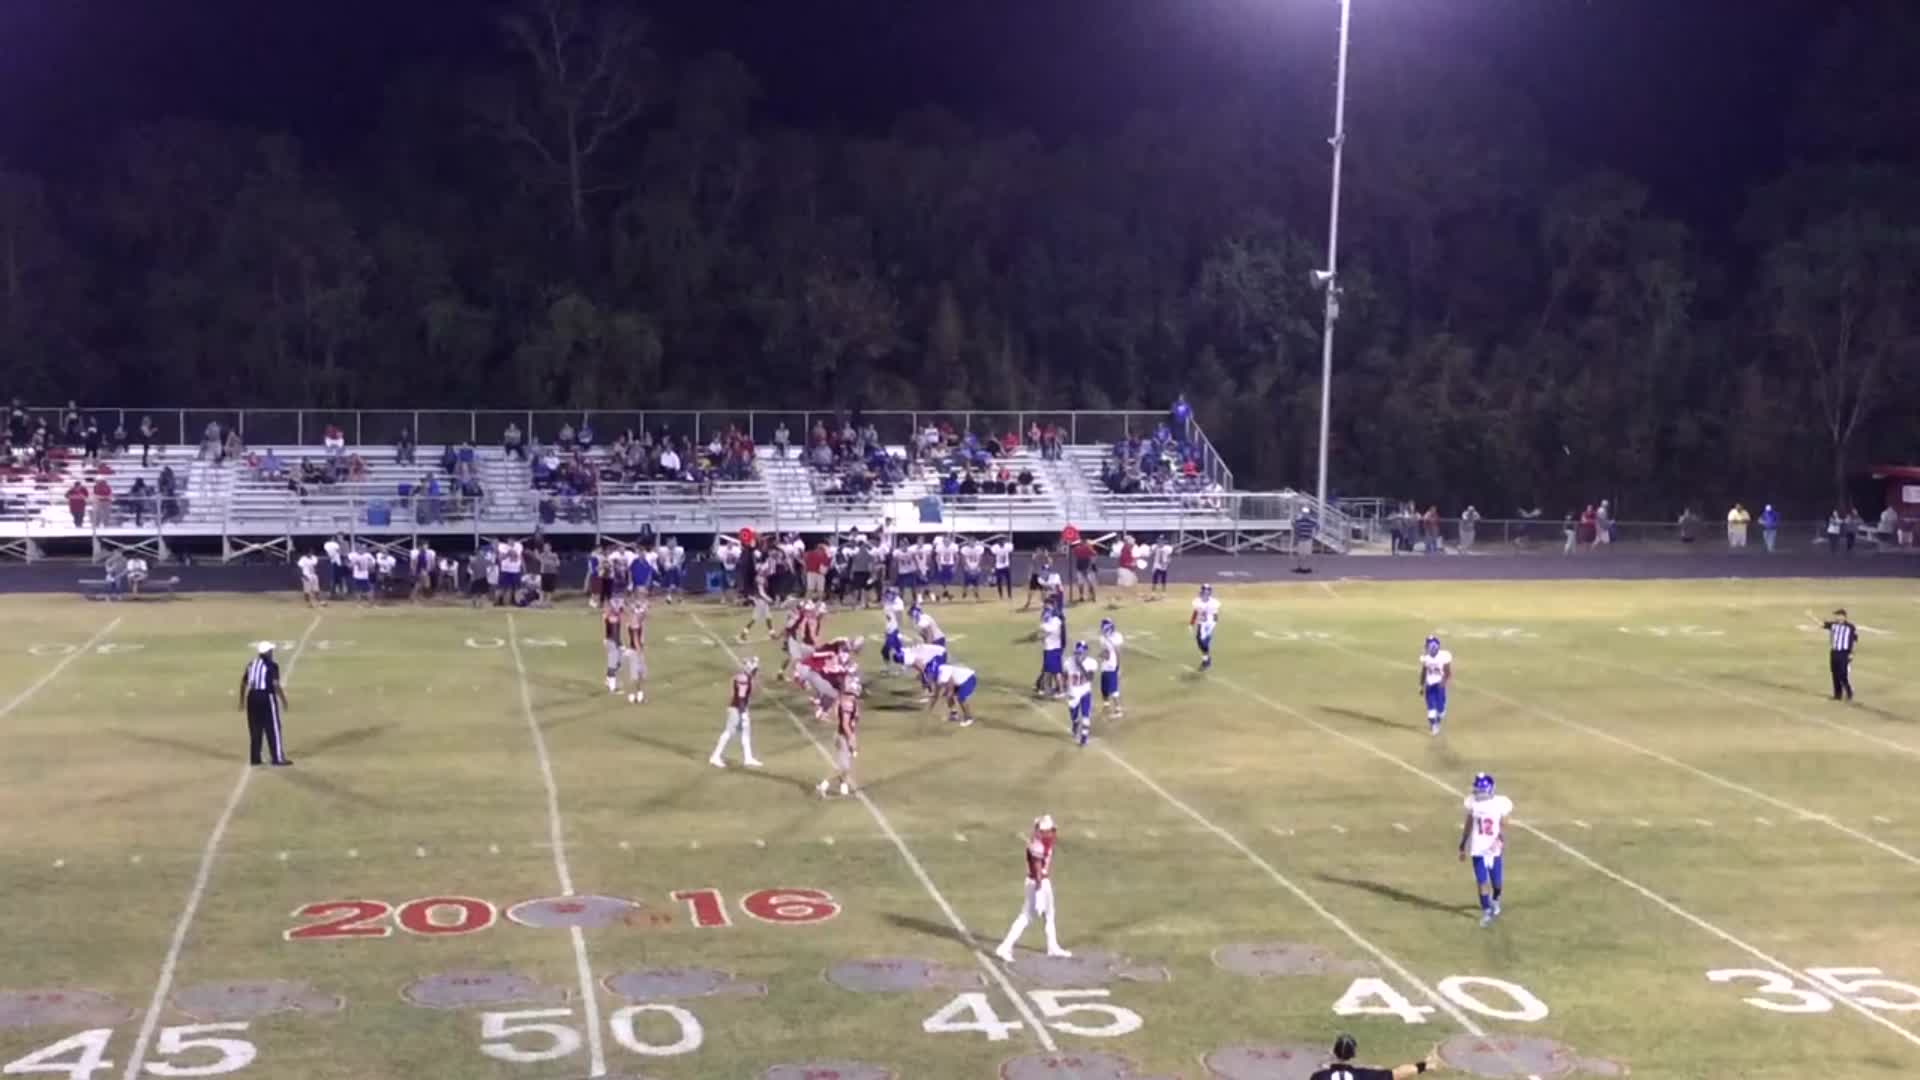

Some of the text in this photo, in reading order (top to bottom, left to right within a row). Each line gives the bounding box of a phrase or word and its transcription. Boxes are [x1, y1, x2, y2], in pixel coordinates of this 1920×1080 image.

[1477, 817, 1494, 836] 12
[922, 988, 1143, 1041] 45
[1332, 975, 1549, 1024] 40
[1705, 967, 1920, 1013] 35
[2, 1022, 257, 1080] 45
[480, 1003, 704, 1062] 50
